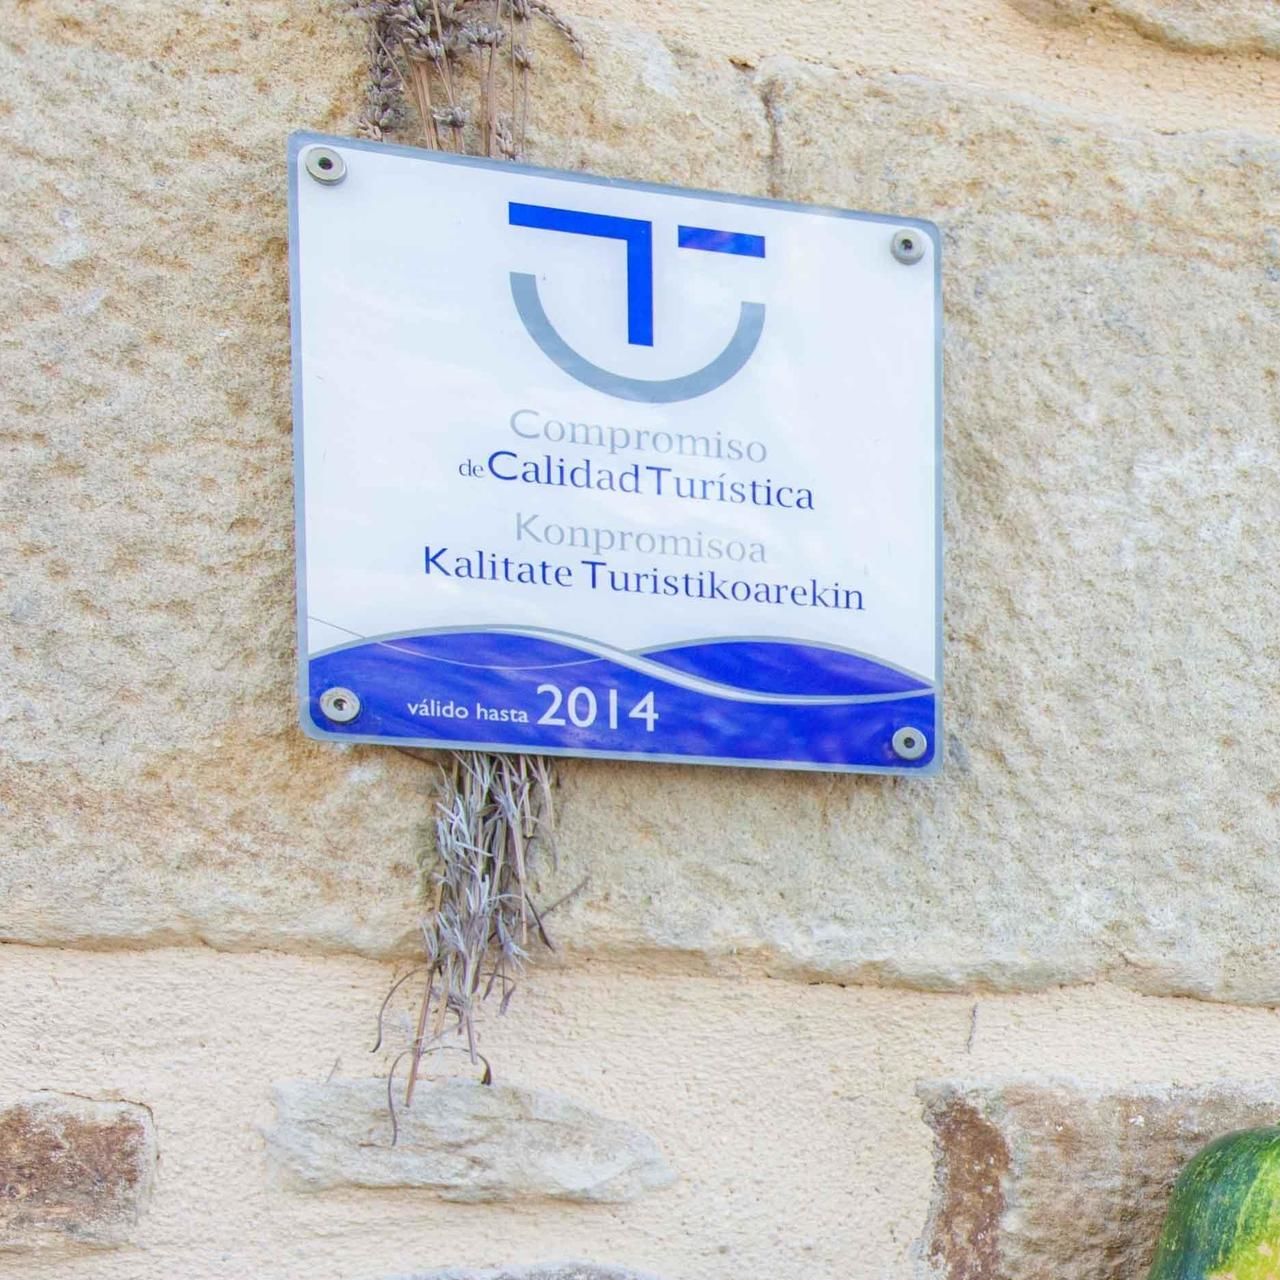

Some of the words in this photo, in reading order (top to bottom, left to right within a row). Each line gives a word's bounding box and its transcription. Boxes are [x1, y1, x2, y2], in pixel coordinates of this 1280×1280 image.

[508, 408, 768, 464] Compromiso
[458, 459, 484, 479] de
[487, 450, 643, 495] Calidad
[645, 465, 816, 511] Turística
[514, 511, 768, 564] Konpromisoa
[423, 545, 573, 588] Kalitate
[580, 559, 867, 611] Turistikoarekin
[406, 698, 469, 720] válido
[476, 702, 530, 724] hasta
[535, 683, 660, 732] 2014
